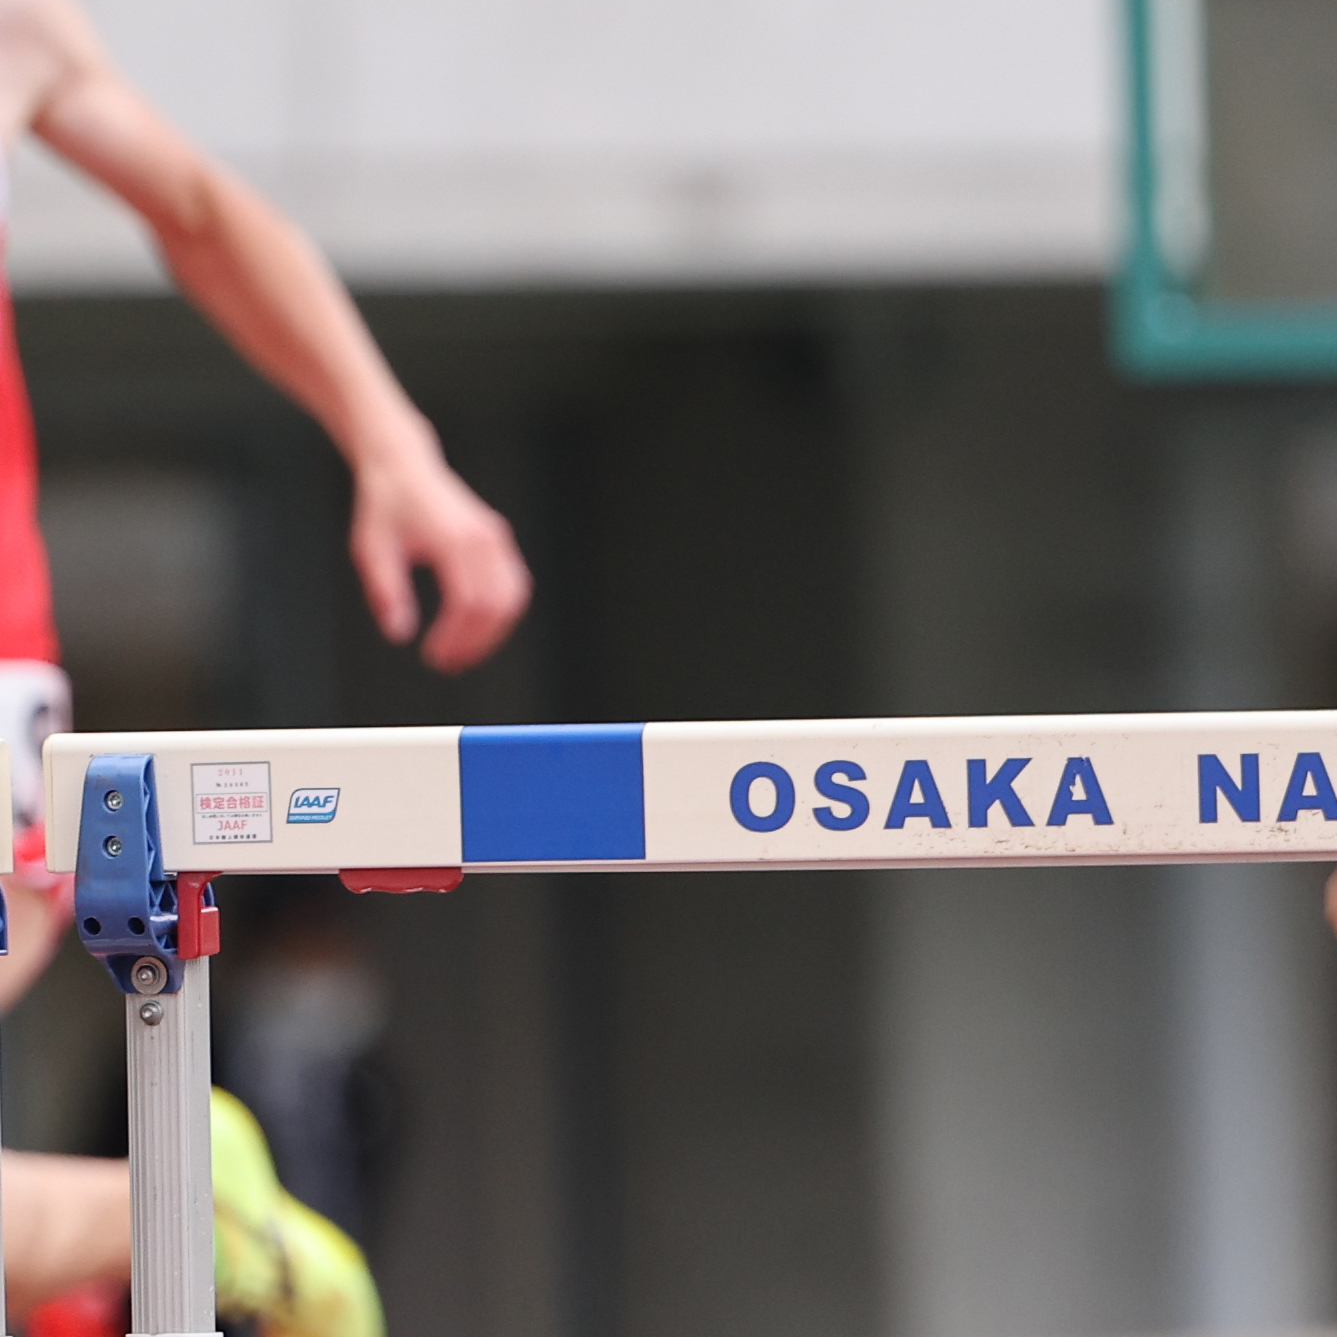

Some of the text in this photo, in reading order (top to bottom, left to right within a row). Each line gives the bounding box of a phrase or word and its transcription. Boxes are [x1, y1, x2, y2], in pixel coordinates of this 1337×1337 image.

[728, 756, 1115, 833] OSAKA
[293, 795, 335, 808] IAAF
[217, 819, 248, 831] JAAF
